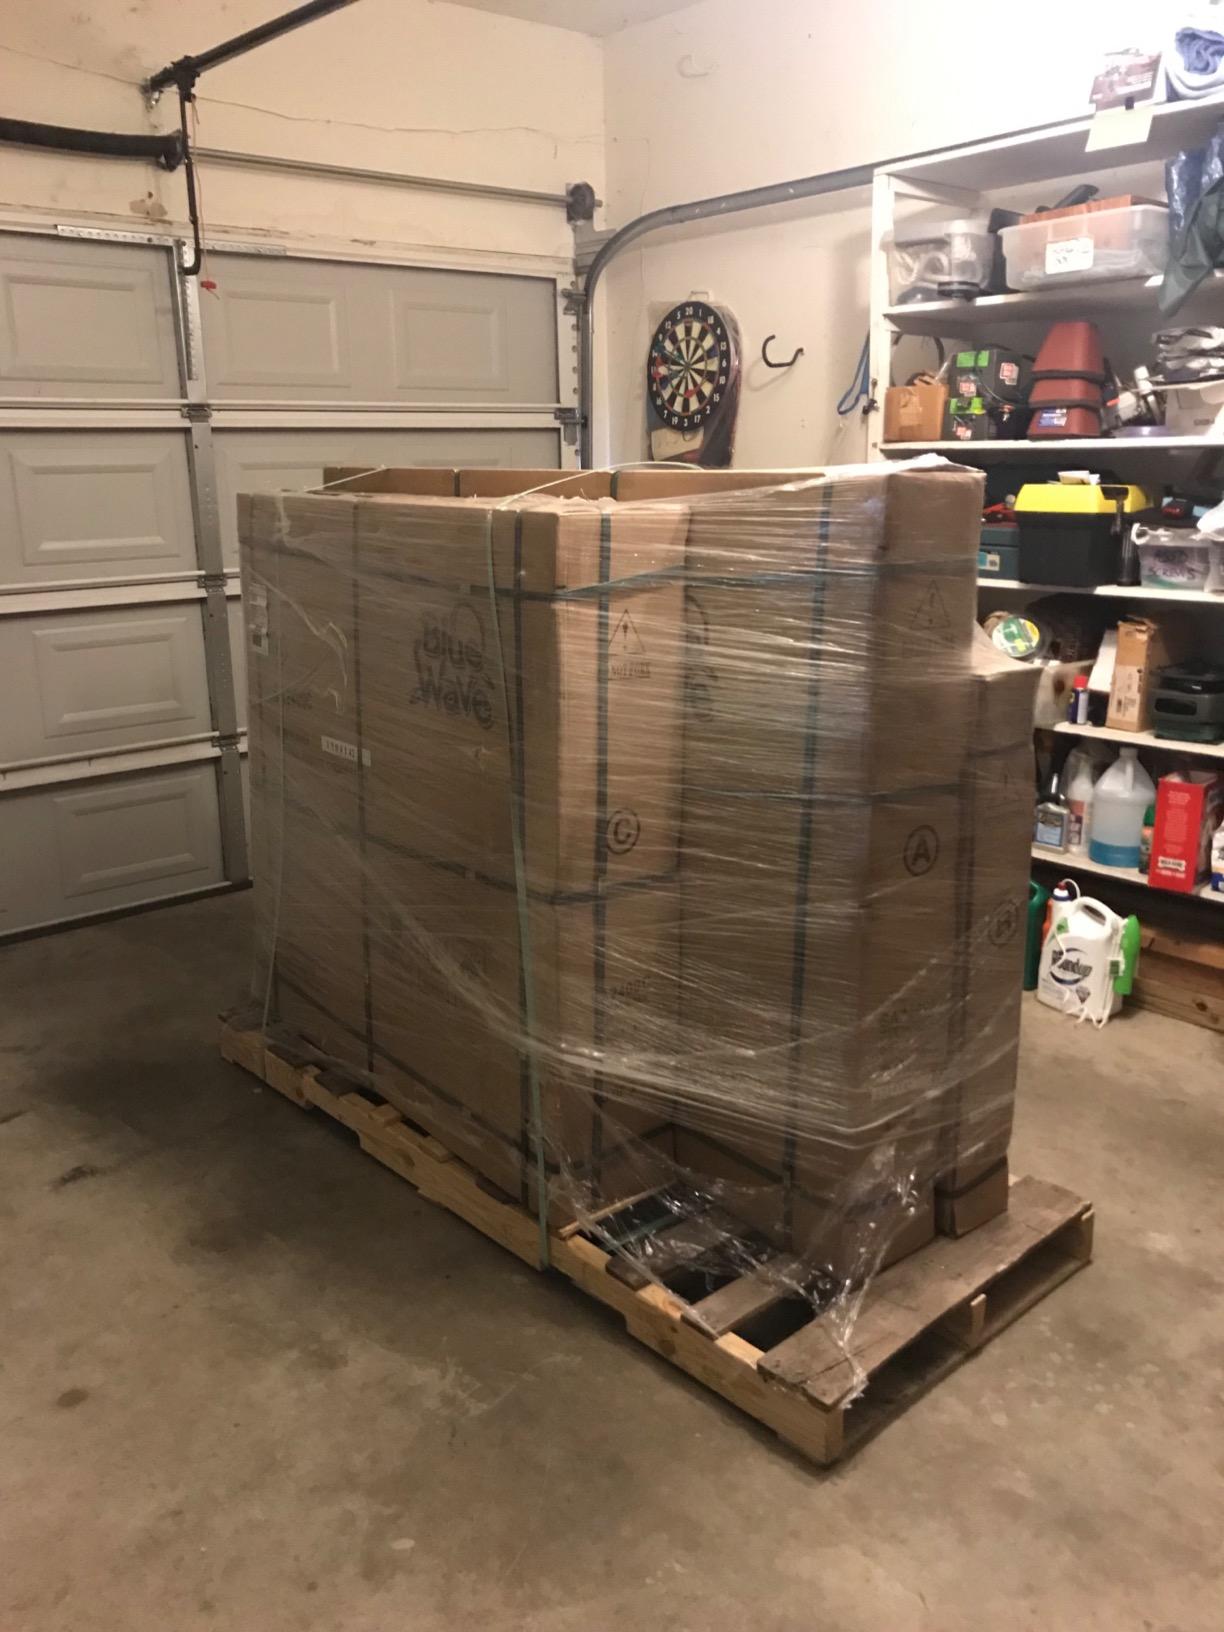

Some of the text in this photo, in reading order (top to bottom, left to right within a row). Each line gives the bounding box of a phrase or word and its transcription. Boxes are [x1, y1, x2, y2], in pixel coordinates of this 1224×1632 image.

[685, 306, 694, 316] 20
[665, 320, 672, 329] 12
[720, 375, 726, 384] 10
[713, 393, 720, 403] 15
[705, 405, 711, 415] 2
[671, 416, 679, 425] 19
[694, 414, 701, 424] 17
[1051, 949, 1093, 979] Rundup
